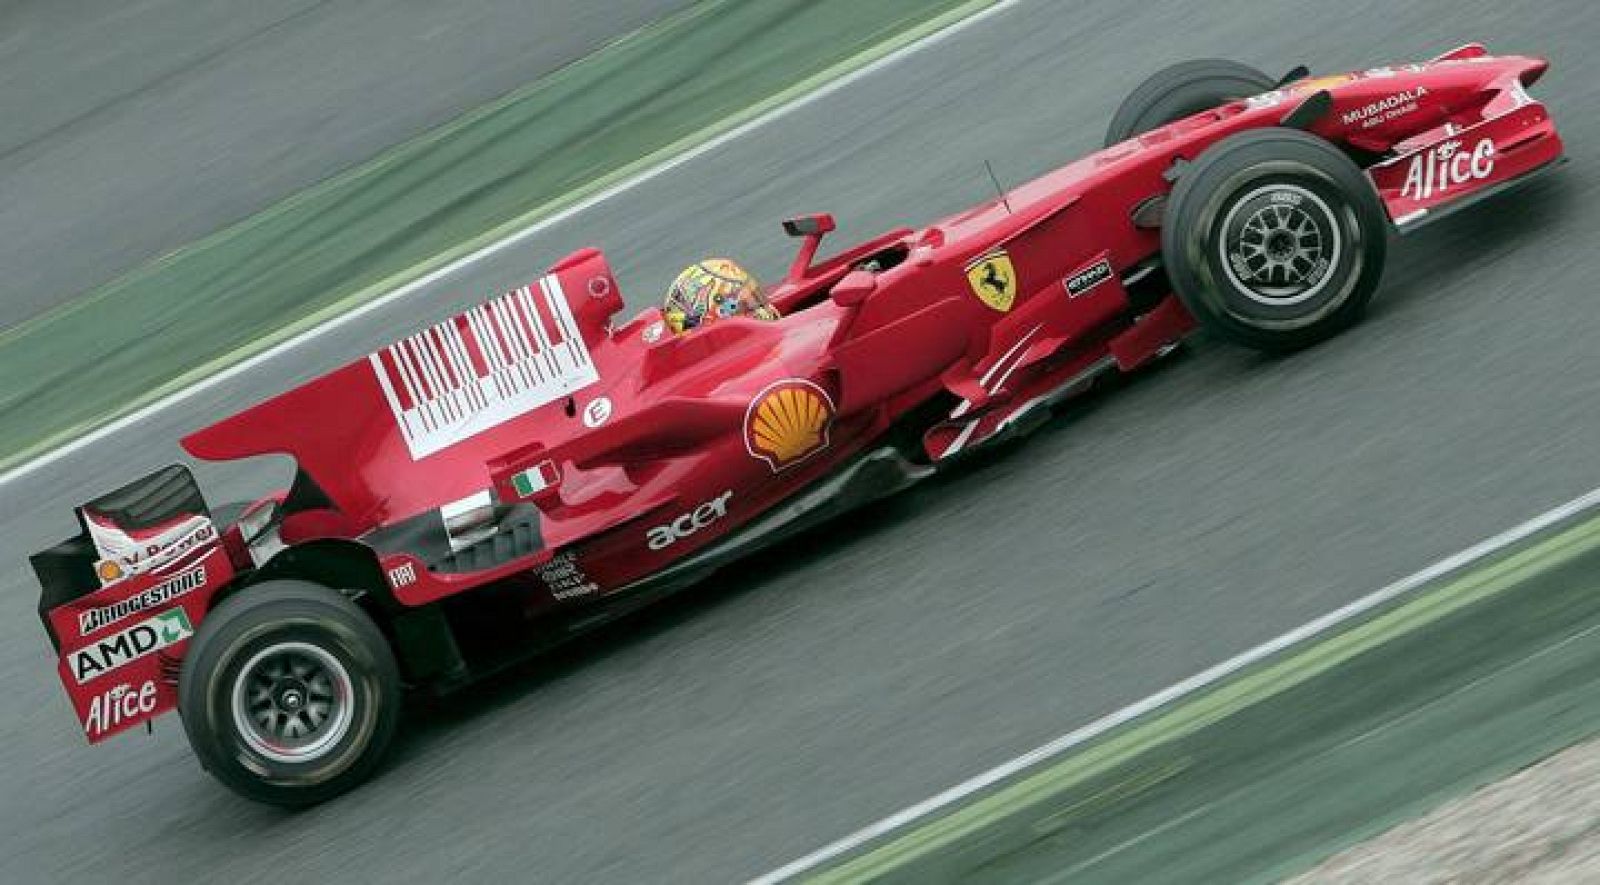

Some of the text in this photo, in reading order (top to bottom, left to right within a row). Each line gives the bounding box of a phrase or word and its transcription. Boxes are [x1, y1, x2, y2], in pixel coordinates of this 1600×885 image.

[1342, 86, 1428, 125] MUBADALA
[1401, 139, 1494, 200] Alice
[646, 490, 733, 550] acer
[82, 568, 205, 633] BRIDGESTONE
[76, 626, 157, 679] AMD
[86, 680, 156, 734] Alice
